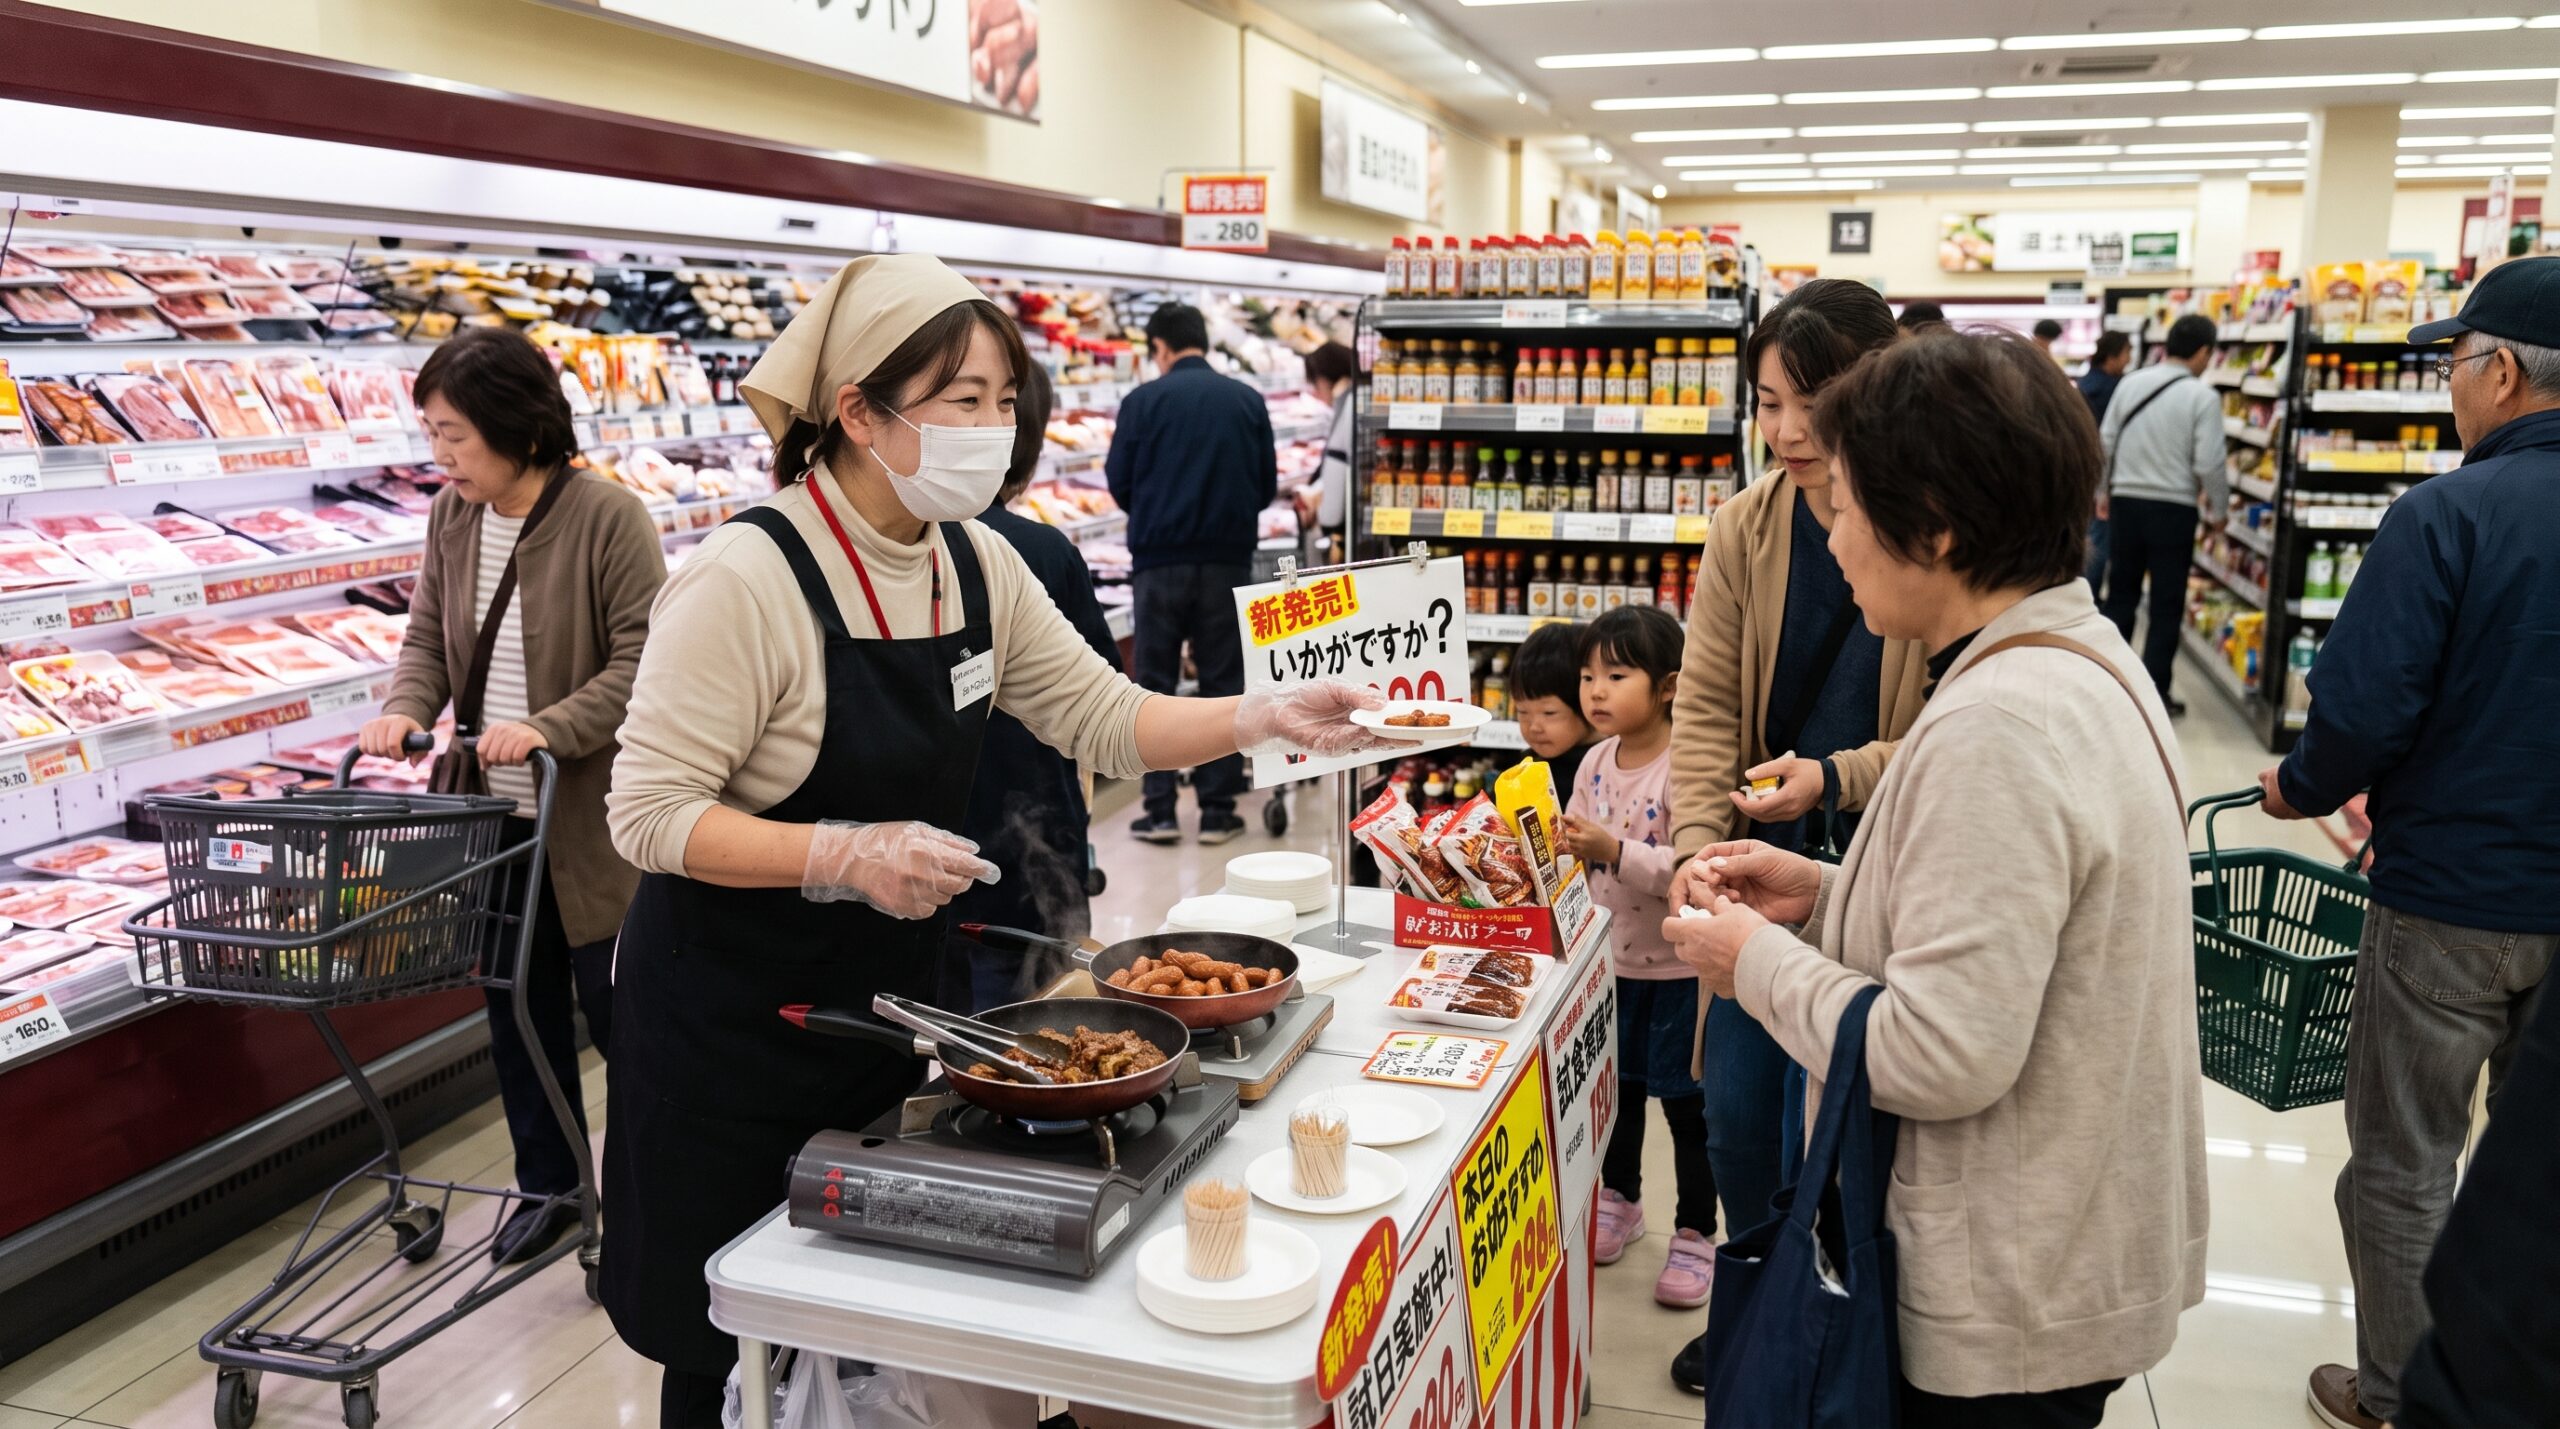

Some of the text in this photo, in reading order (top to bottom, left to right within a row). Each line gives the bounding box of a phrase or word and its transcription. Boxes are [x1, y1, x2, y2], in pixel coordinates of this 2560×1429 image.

[1217, 221, 1259, 241] 280
[1250, 574, 1356, 640] 新発売!
[1269, 597, 1453, 682] いかがですか?
[1462, 1124, 1509, 1225] 本日の
